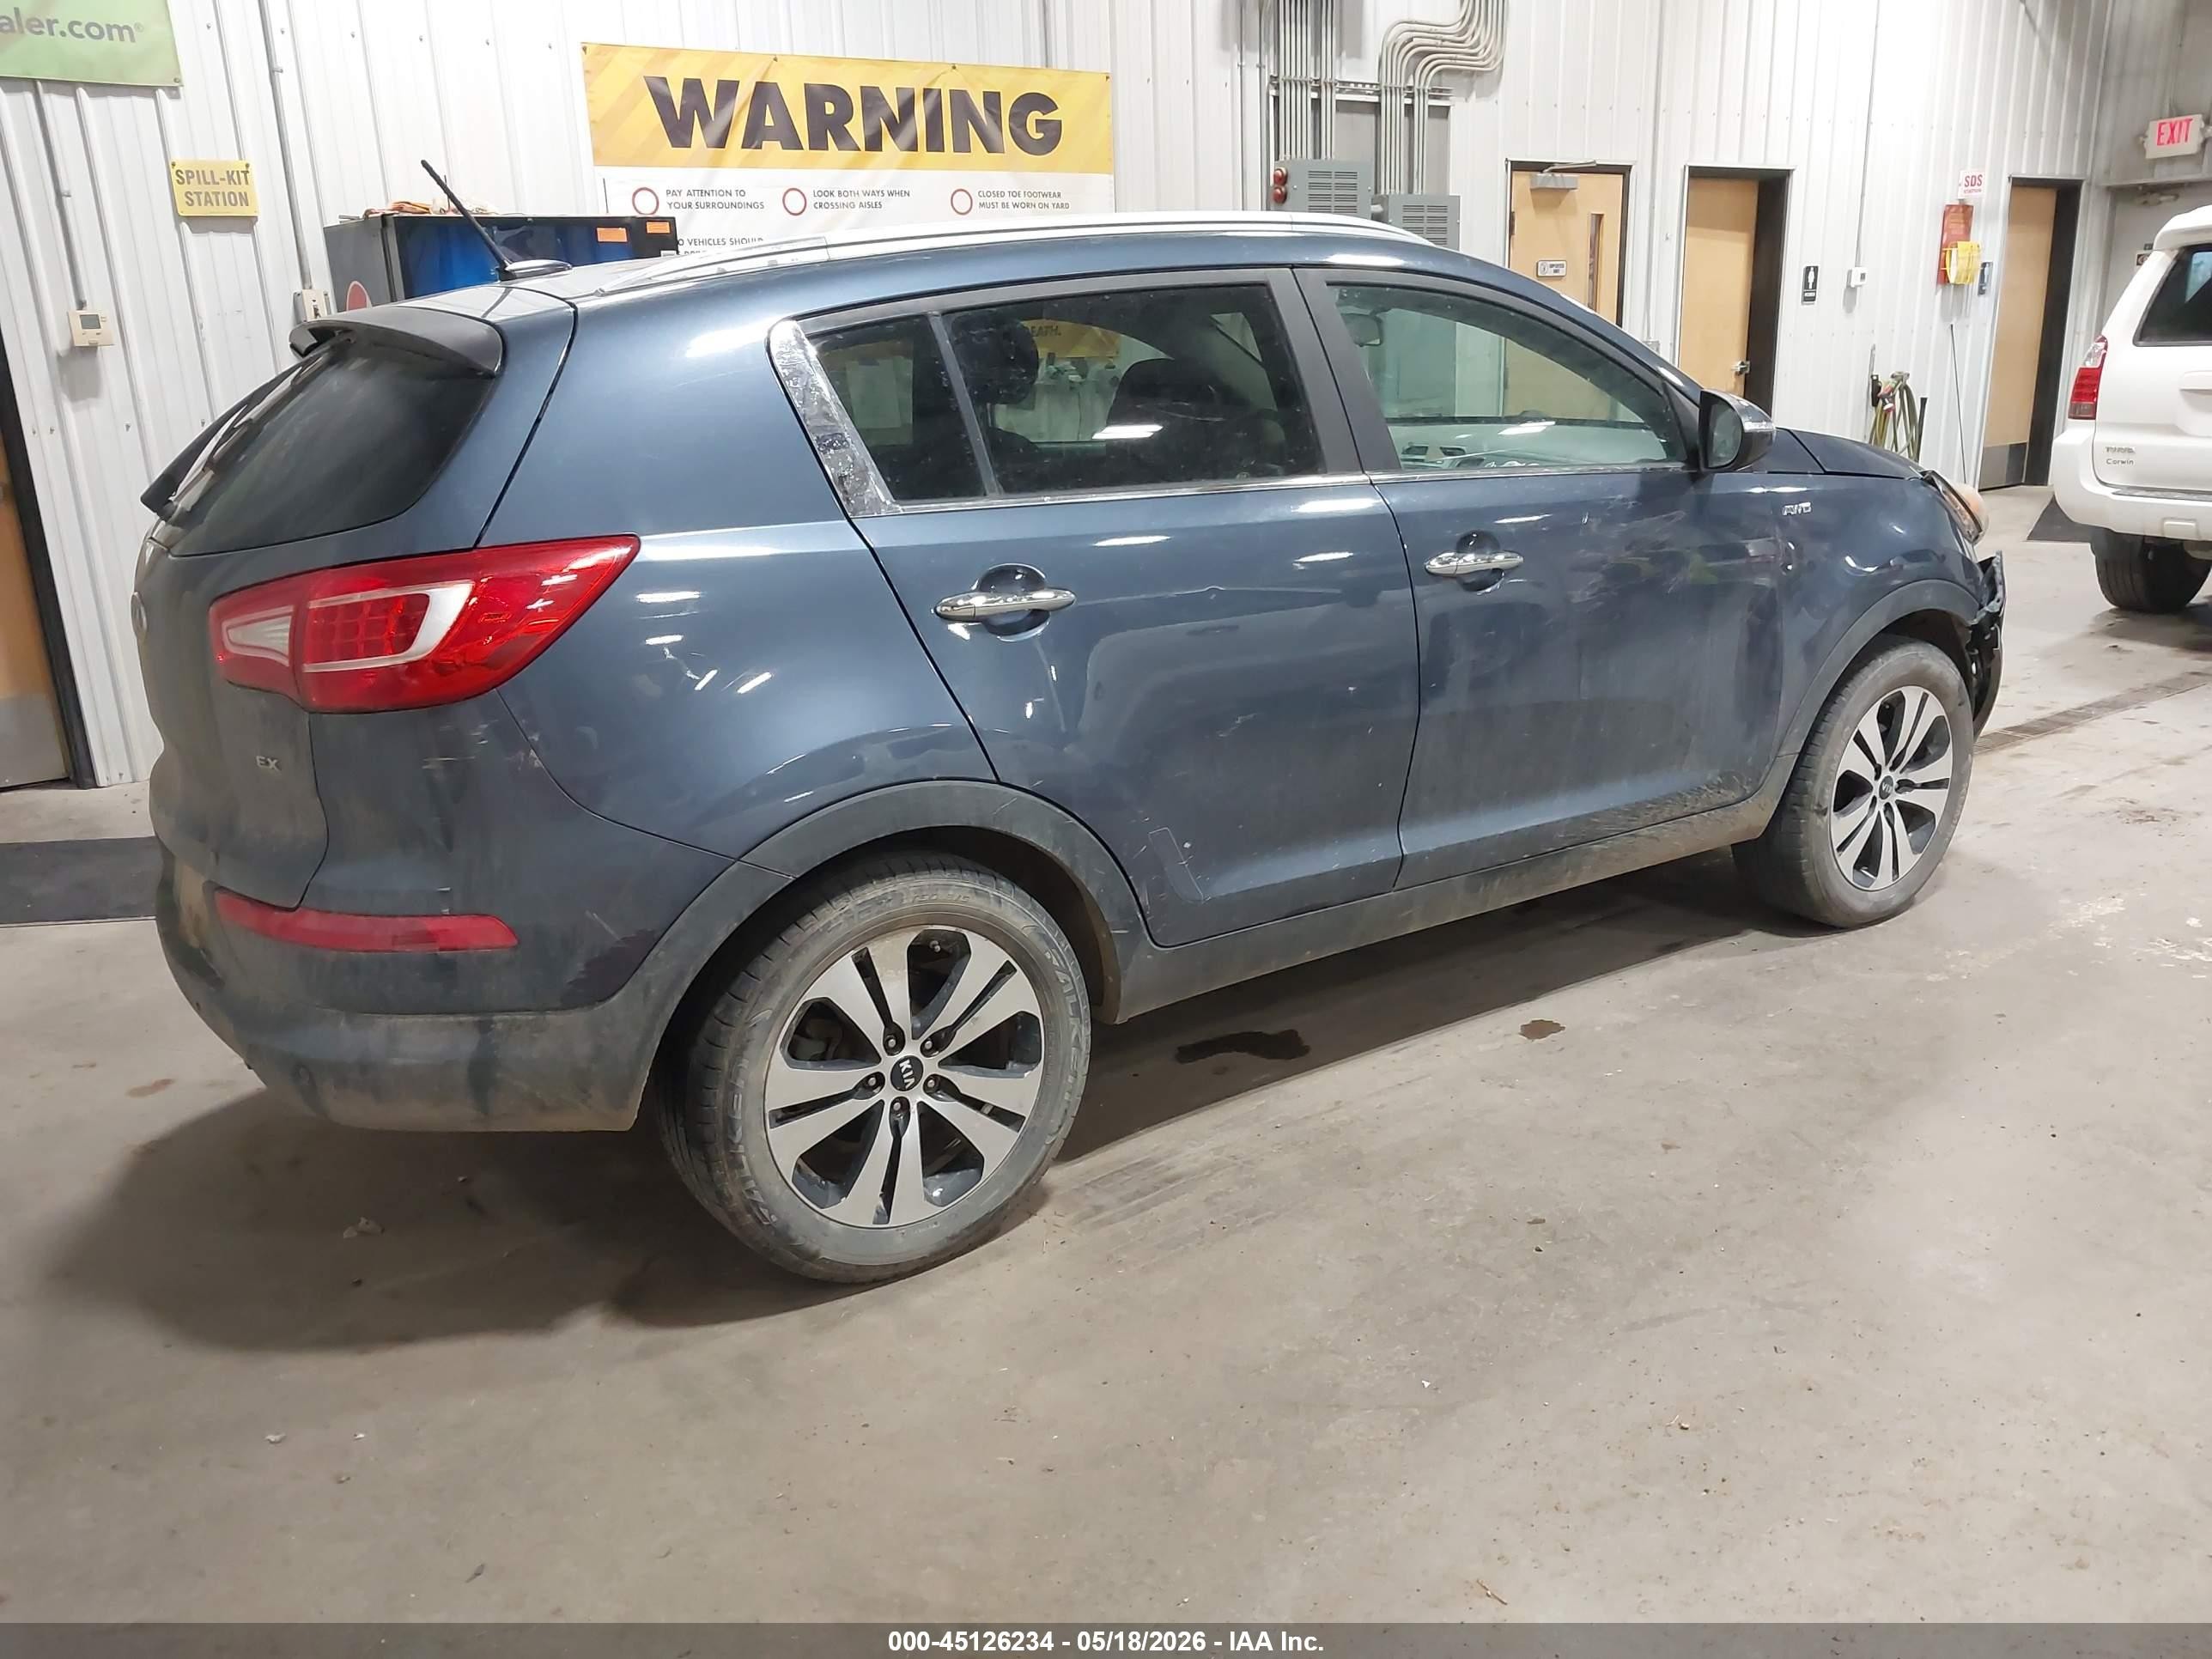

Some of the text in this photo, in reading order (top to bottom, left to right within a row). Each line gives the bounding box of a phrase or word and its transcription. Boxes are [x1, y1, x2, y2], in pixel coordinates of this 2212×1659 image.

[643, 76, 1062, 155] WARNING
[2156, 118, 2193, 146] EXIT
[175, 169, 250, 185] SPILL-KIT
[1964, 173, 1983, 187] SDS
[184, 191, 249, 207] STATION
[665, 189, 746, 198] PAY ATTENTION TO
[812, 189, 910, 198] LOOK BOTH WAYS WHEN
[977, 190, 1061, 199] CLOSED TOE FOOTWEAR
[666, 201, 765, 210] YOUR SURROUNDINGS
[813, 201, 883, 210] CROSSING AISLES
[978, 201, 999, 210] MUST
[1012, 201, 1036, 210] WORN
[687, 238, 726, 246] VEHICLES
[255, 755, 281, 772] EX
[899, 1059, 915, 1090] KIA
